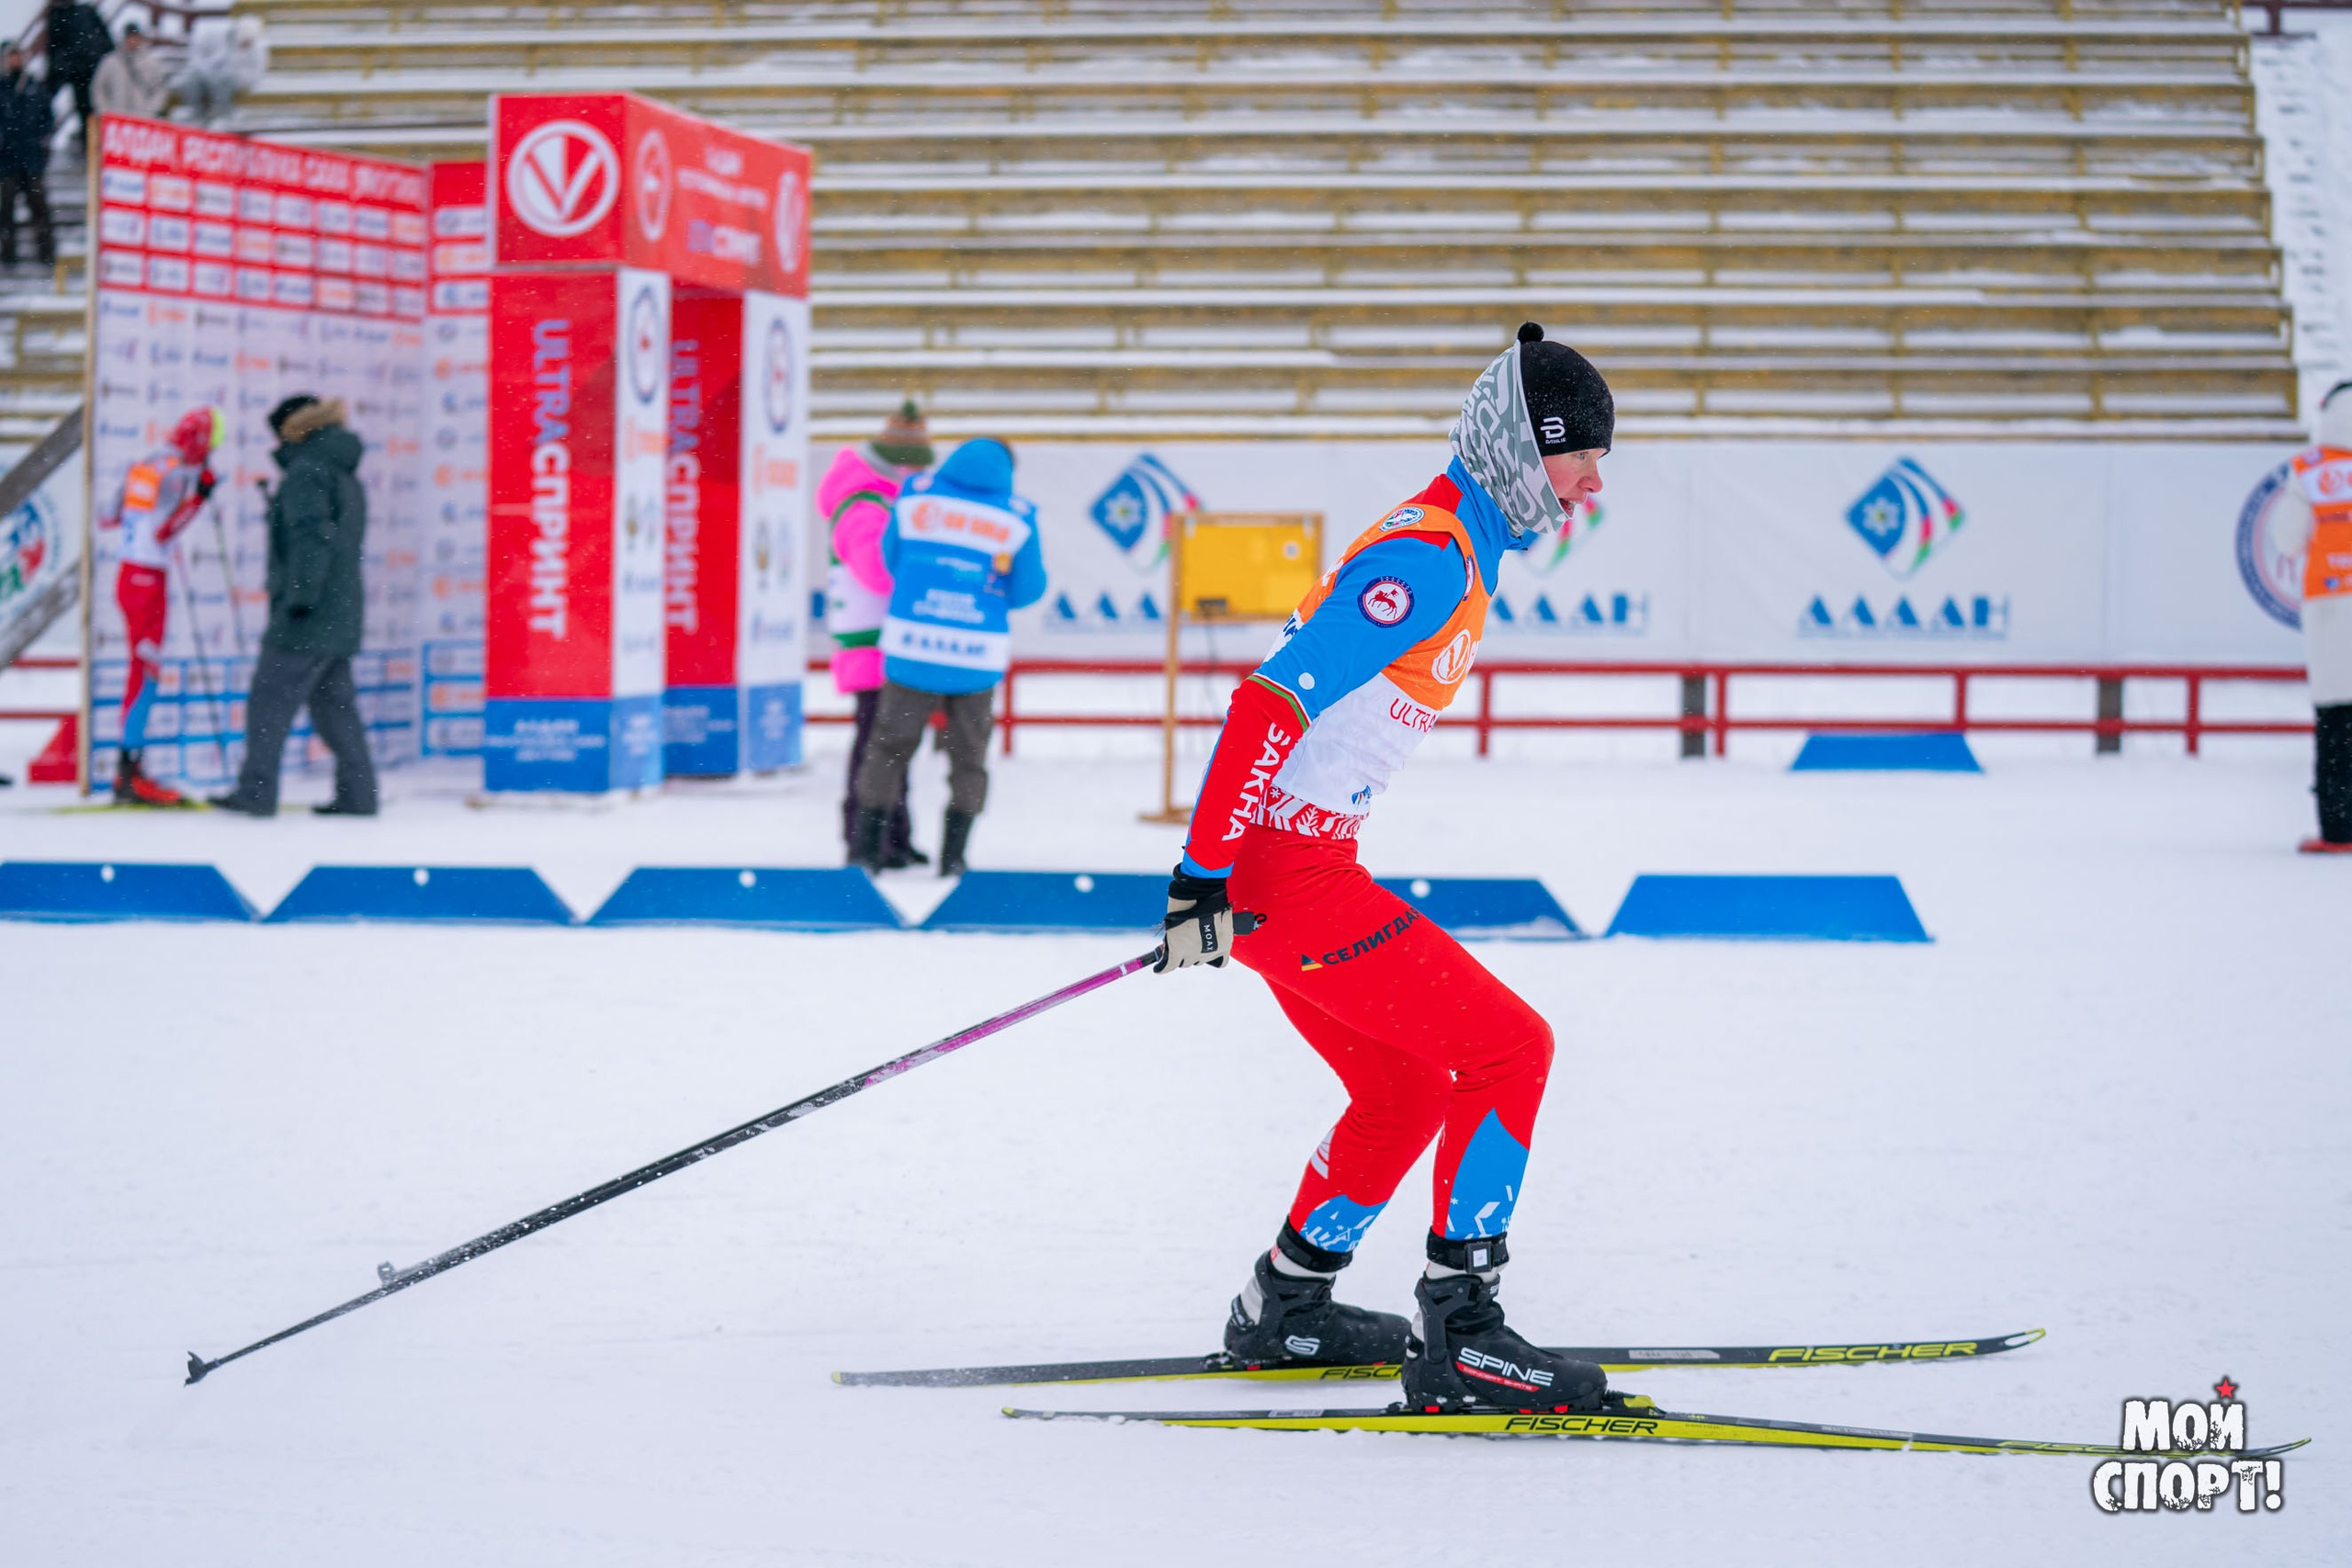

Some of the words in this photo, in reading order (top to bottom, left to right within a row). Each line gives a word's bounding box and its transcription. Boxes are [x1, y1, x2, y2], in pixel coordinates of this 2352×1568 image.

[1221, 722, 1291, 841] SAKHA
[1768, 1341, 1978, 1361] FISCHER
[1458, 1347, 1555, 1387] SPINE
[1504, 1416, 1659, 1435] FISCHER
